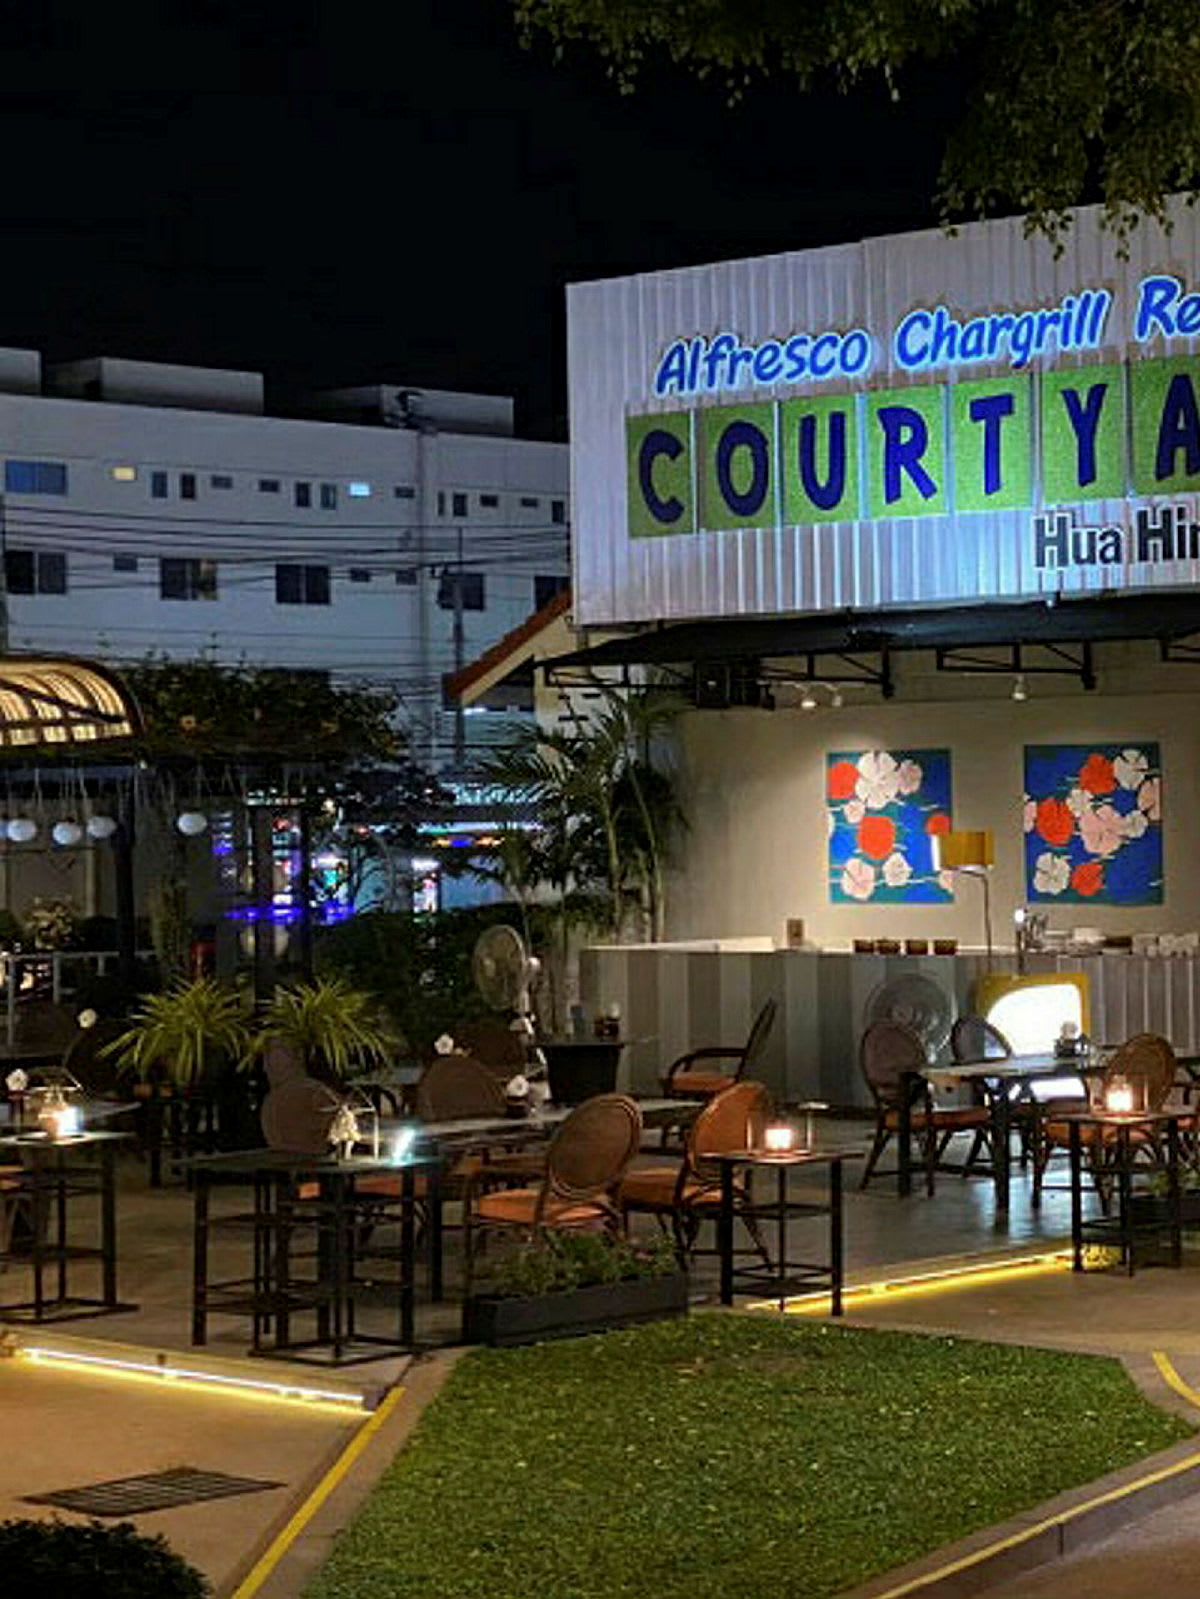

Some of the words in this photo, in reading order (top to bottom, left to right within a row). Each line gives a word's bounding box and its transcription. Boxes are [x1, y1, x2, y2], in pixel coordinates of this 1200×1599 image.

[654, 329, 870, 395] Alfresco
[896, 291, 1109, 369] Chargrill
[1034, 512, 1121, 568] Hua
